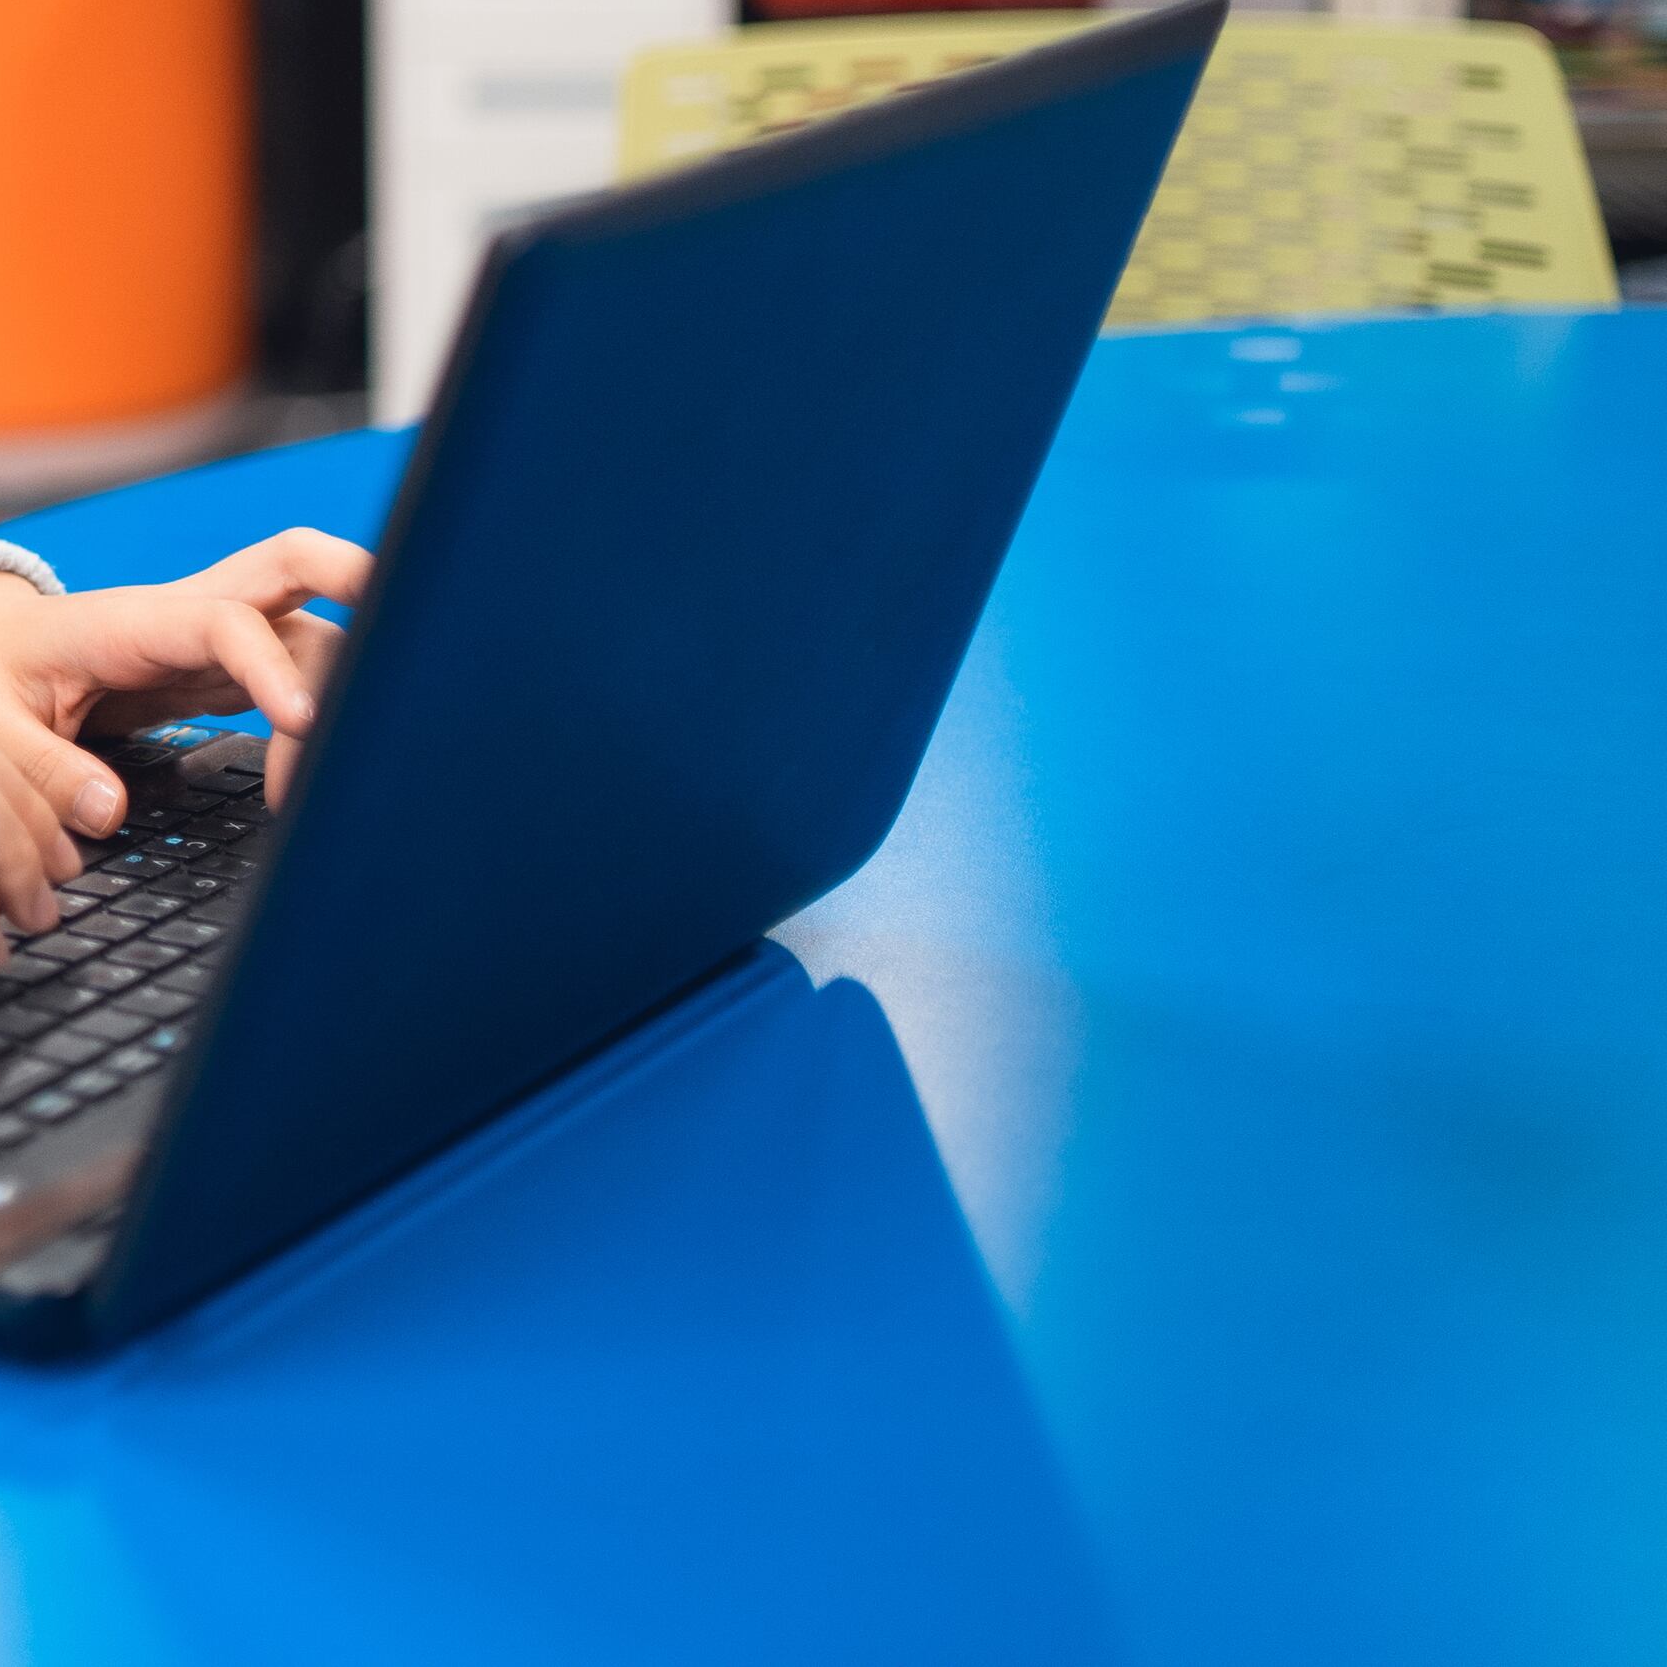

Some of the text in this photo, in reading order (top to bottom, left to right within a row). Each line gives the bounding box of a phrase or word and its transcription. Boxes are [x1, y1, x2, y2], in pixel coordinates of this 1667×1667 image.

[224, 822, 246, 830] X
[187, 841, 207, 849] C
[153, 859, 172, 868] V
[195, 879, 217, 889] G
